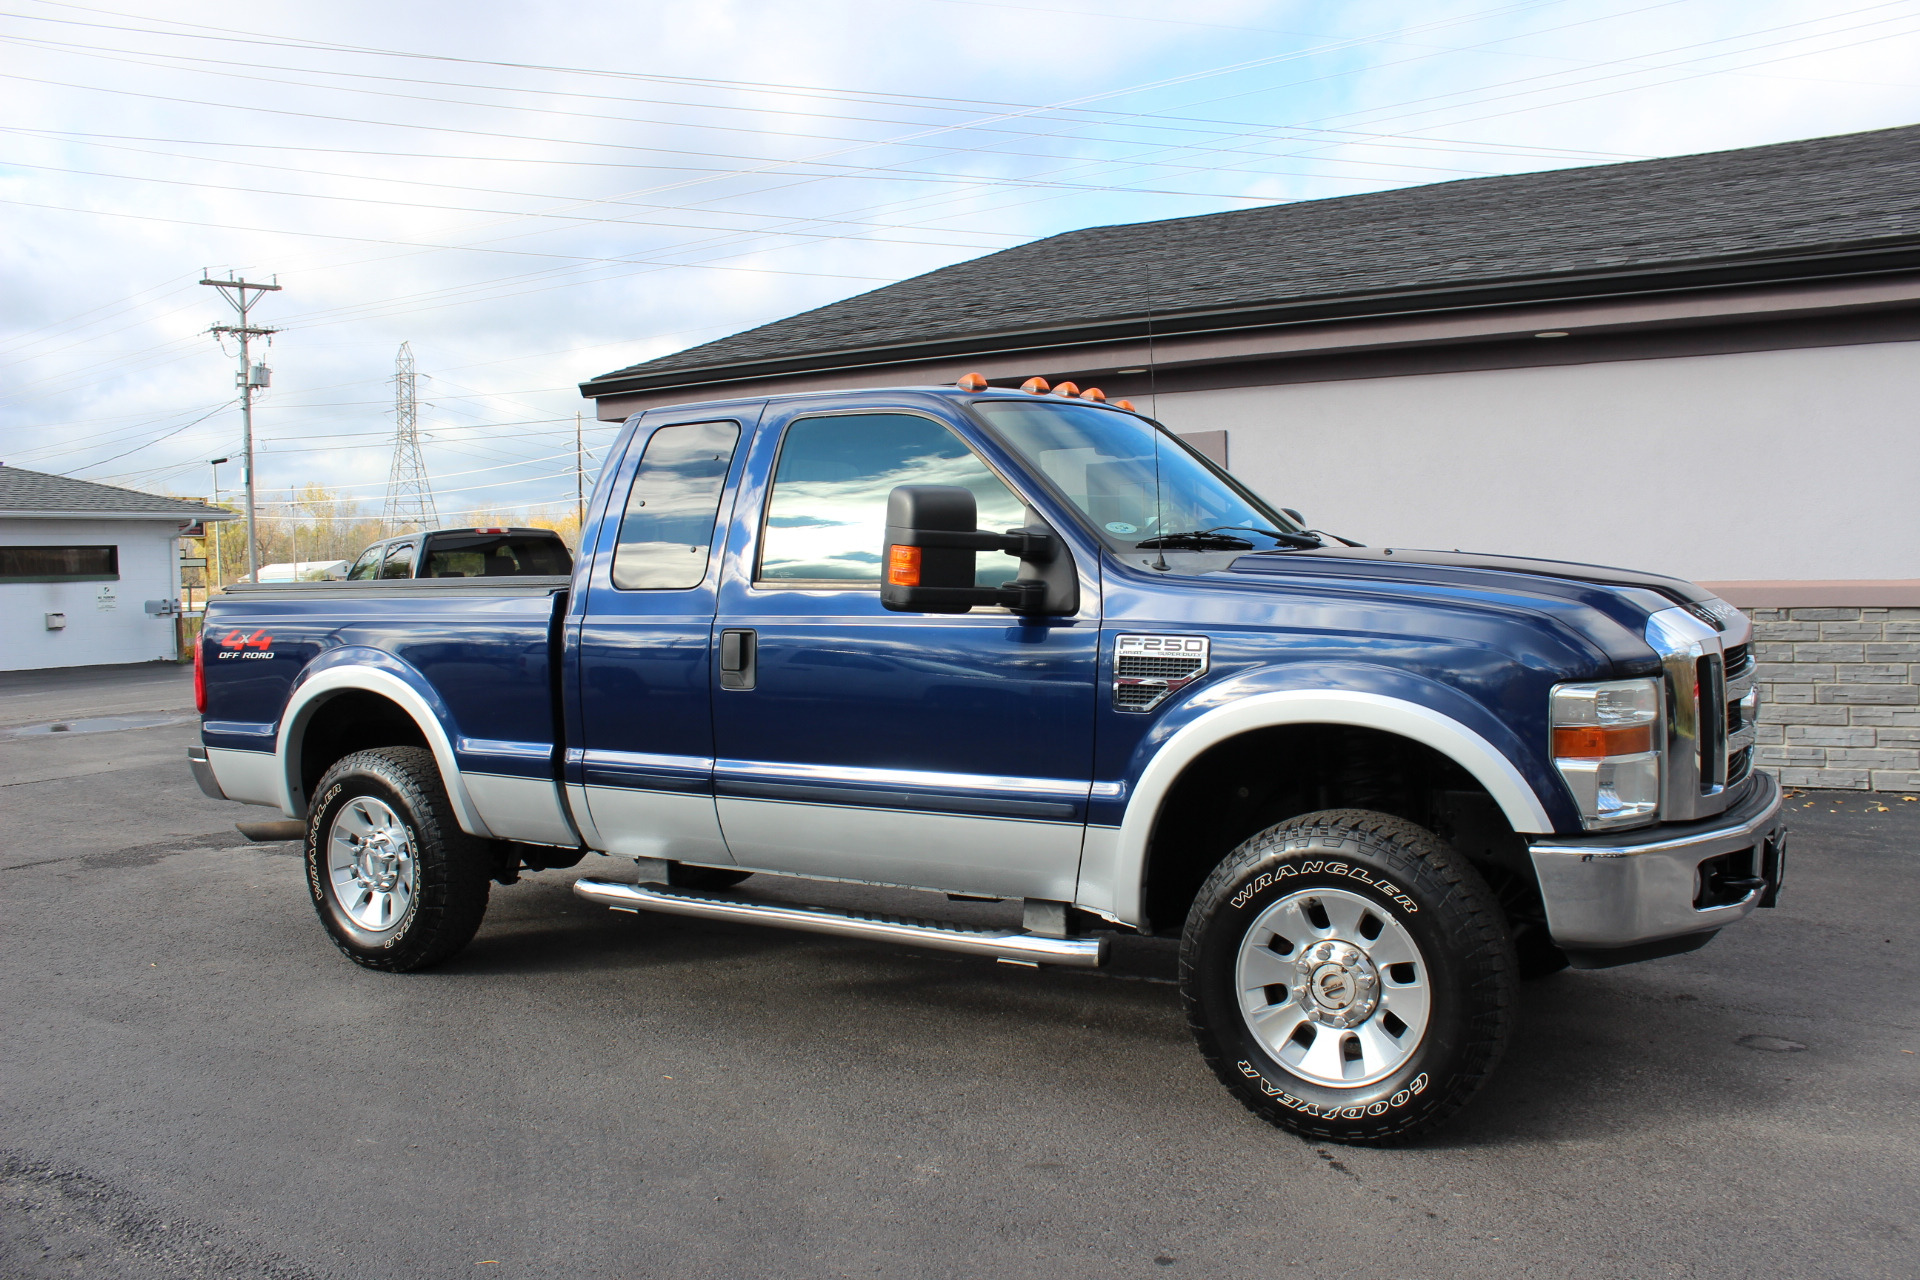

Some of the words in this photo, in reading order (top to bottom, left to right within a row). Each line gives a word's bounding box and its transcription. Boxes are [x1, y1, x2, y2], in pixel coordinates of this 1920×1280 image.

[218, 651, 240, 659] OFF
[1119, 637, 1203, 652] F-250
[310, 783, 342, 901] WRANGLER
[1230, 860, 1419, 914] WRANGLER
[1237, 1059, 1429, 1121] GOODYEAR
